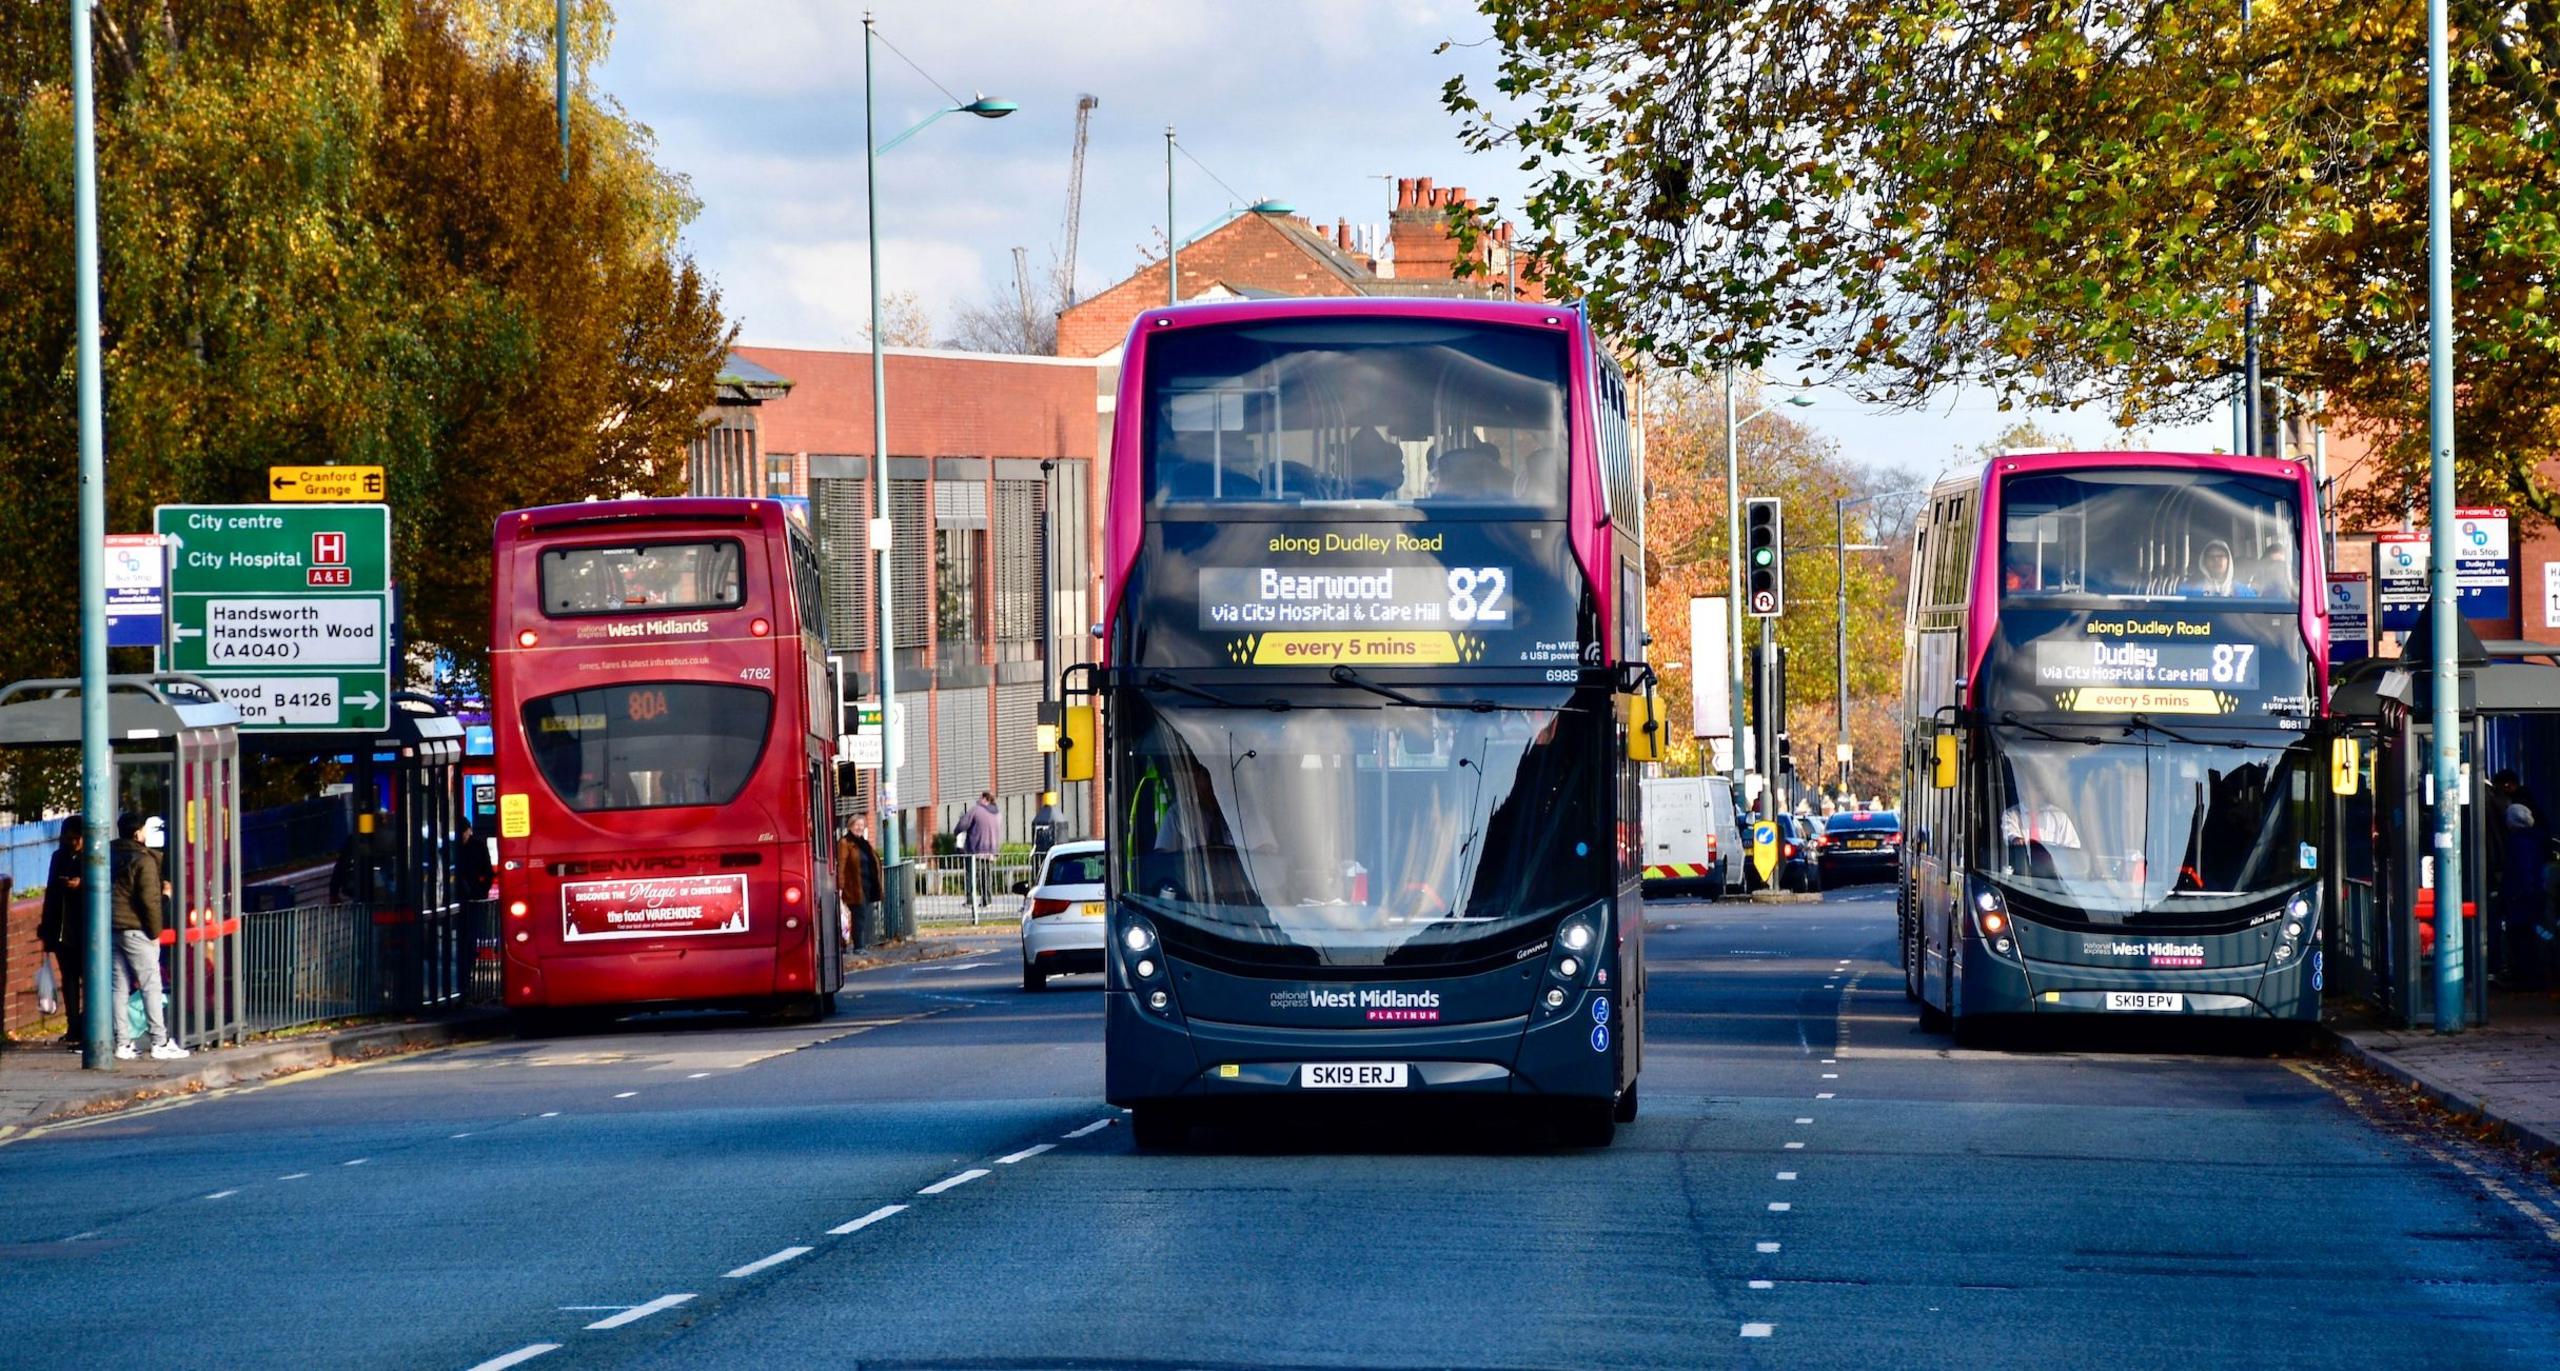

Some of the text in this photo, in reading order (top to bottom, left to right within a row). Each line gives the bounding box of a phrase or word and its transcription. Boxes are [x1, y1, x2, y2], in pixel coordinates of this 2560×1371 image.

[300, 472, 357, 482] Cranford
[305, 484, 351, 496] Grange
[2493, 508, 2507, 517] CG
[188, 514, 283, 531] City centre
[317, 535, 340, 562] H
[1269, 533, 1443, 555] along Dudley Road
[2479, 548, 2499, 557] Stop
[188, 552, 302, 569] City Hospital
[1260, 567, 1507, 621] Bearwood 82
[214, 607, 318, 620] Handsworth
[1211, 603, 1441, 621] via City Hospital & Cape Hill
[214, 624, 374, 638] Handsworth Wood
[577, 624, 608, 634] national
[608, 618, 709, 638] West Midlands
[2087, 620, 2211, 637] along Dudley Road
[577, 632, 608, 640] express
[213, 643, 300, 658] (A4040)
[1284, 641, 1349, 660] every
[1349, 639, 1361, 656] 5
[1366, 637, 1416, 656] mins
[1536, 641, 1579, 650] Free WiFi
[602, 661, 621, 670] fares
[628, 659, 650, 668] latest
[650, 658, 665, 667] info
[665, 656, 710, 667] nxbus.co.uk
[1520, 651, 1579, 662] & USB power
[2094, 642, 2255, 683] Dudley 87
[740, 668, 771, 679] 4762
[1546, 669, 1578, 681] 6985
[2042, 666, 2208, 682] via City Hospital & Cape Hill
[629, 691, 668, 721] 80A
[2096, 694, 2189, 709] every 5 mins
[575, 883, 733, 908] DISCOVER THE Magic OF CHRISTMAS
[607, 906, 703, 923] the food WAREHOUSE
[1516, 940, 1548, 960] Gemma
[2083, 942, 2111, 950] national
[2112, 942, 2204, 957] West Midlands
[1270, 990, 1308, 1000] national
[1310, 990, 1440, 1008] West Midlands
[2115, 995, 2174, 1007] SK19 EPV
[1270, 1000, 1309, 1009] express
[1369, 1011, 1437, 1020] PLATINUM
[1312, 1066, 1396, 1084] SK19 ERJ
